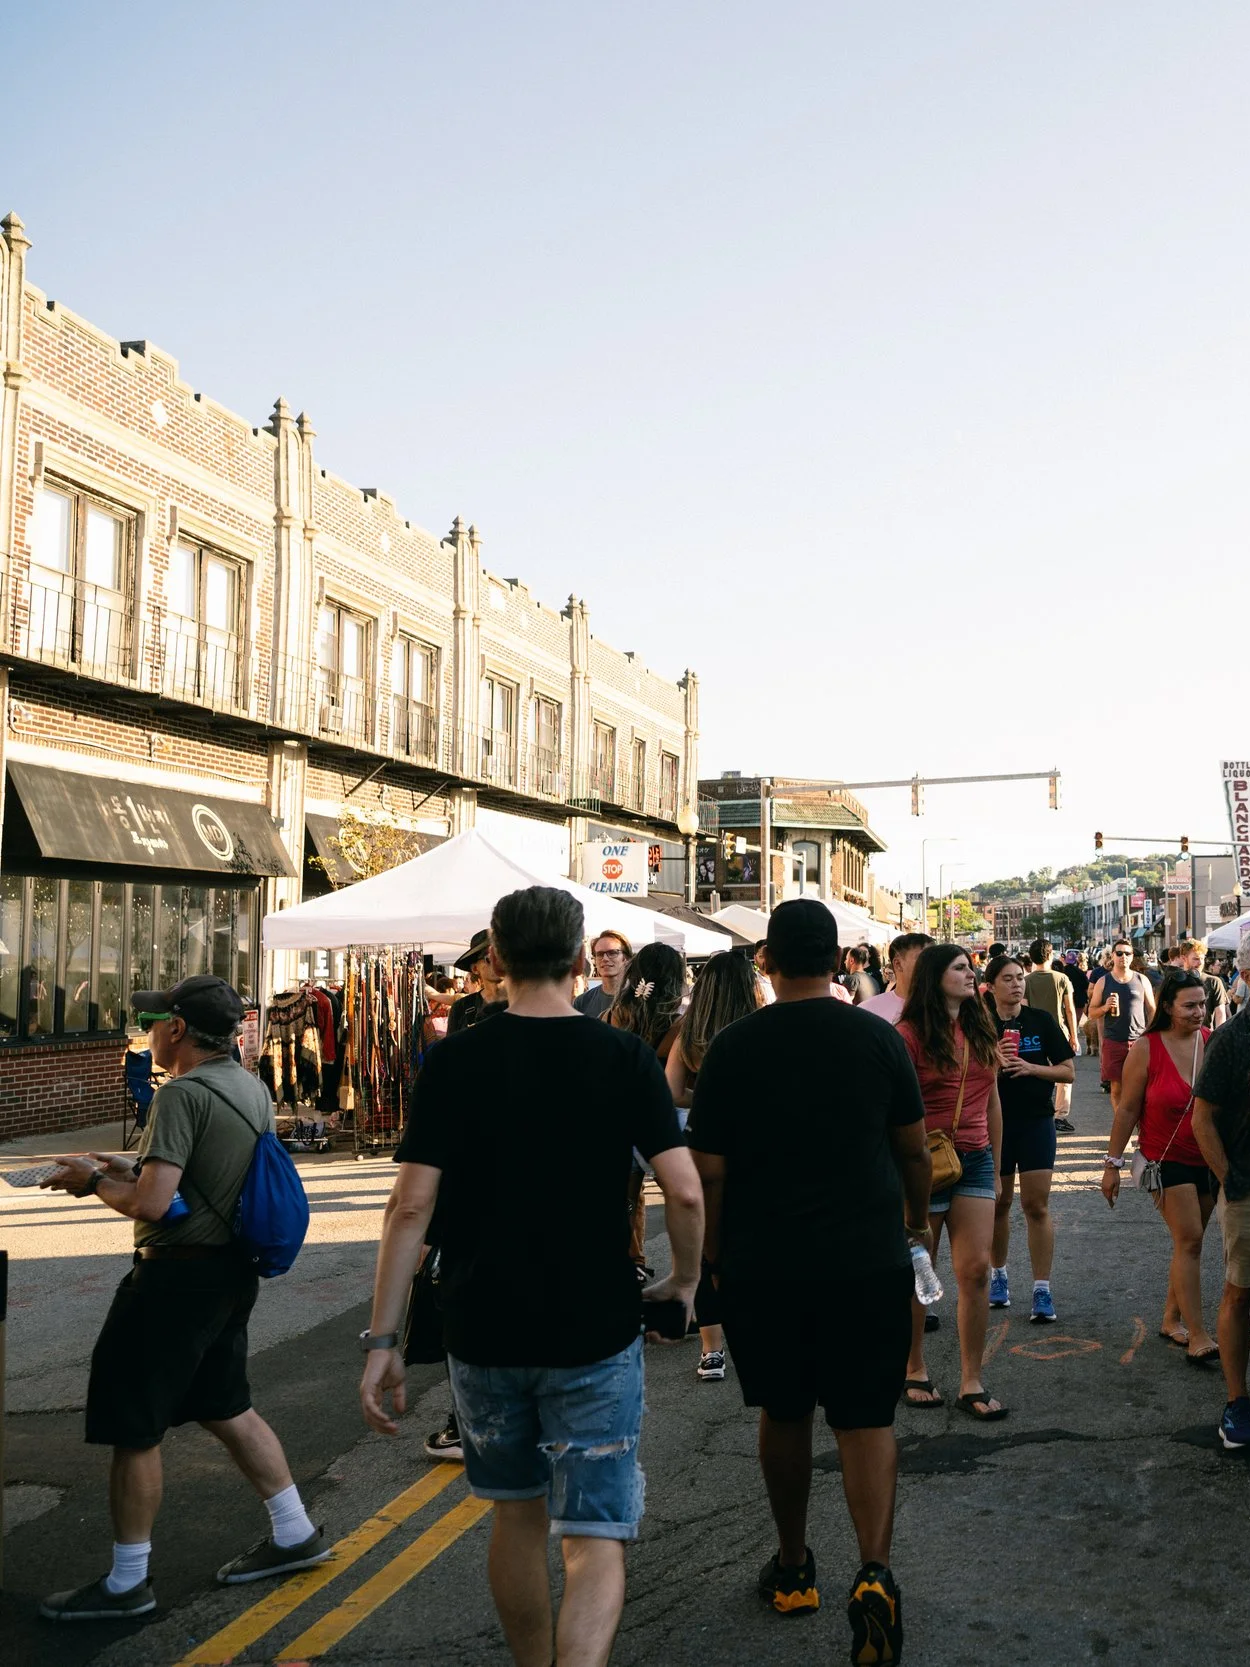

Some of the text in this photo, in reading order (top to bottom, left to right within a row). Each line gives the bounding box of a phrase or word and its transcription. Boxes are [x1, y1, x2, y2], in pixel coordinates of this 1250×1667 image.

[201, 823, 225, 842] MD
[602, 845, 629, 857] ONE
[603, 864, 623, 875] STOP
[588, 882, 640, 893] CLEANERS
